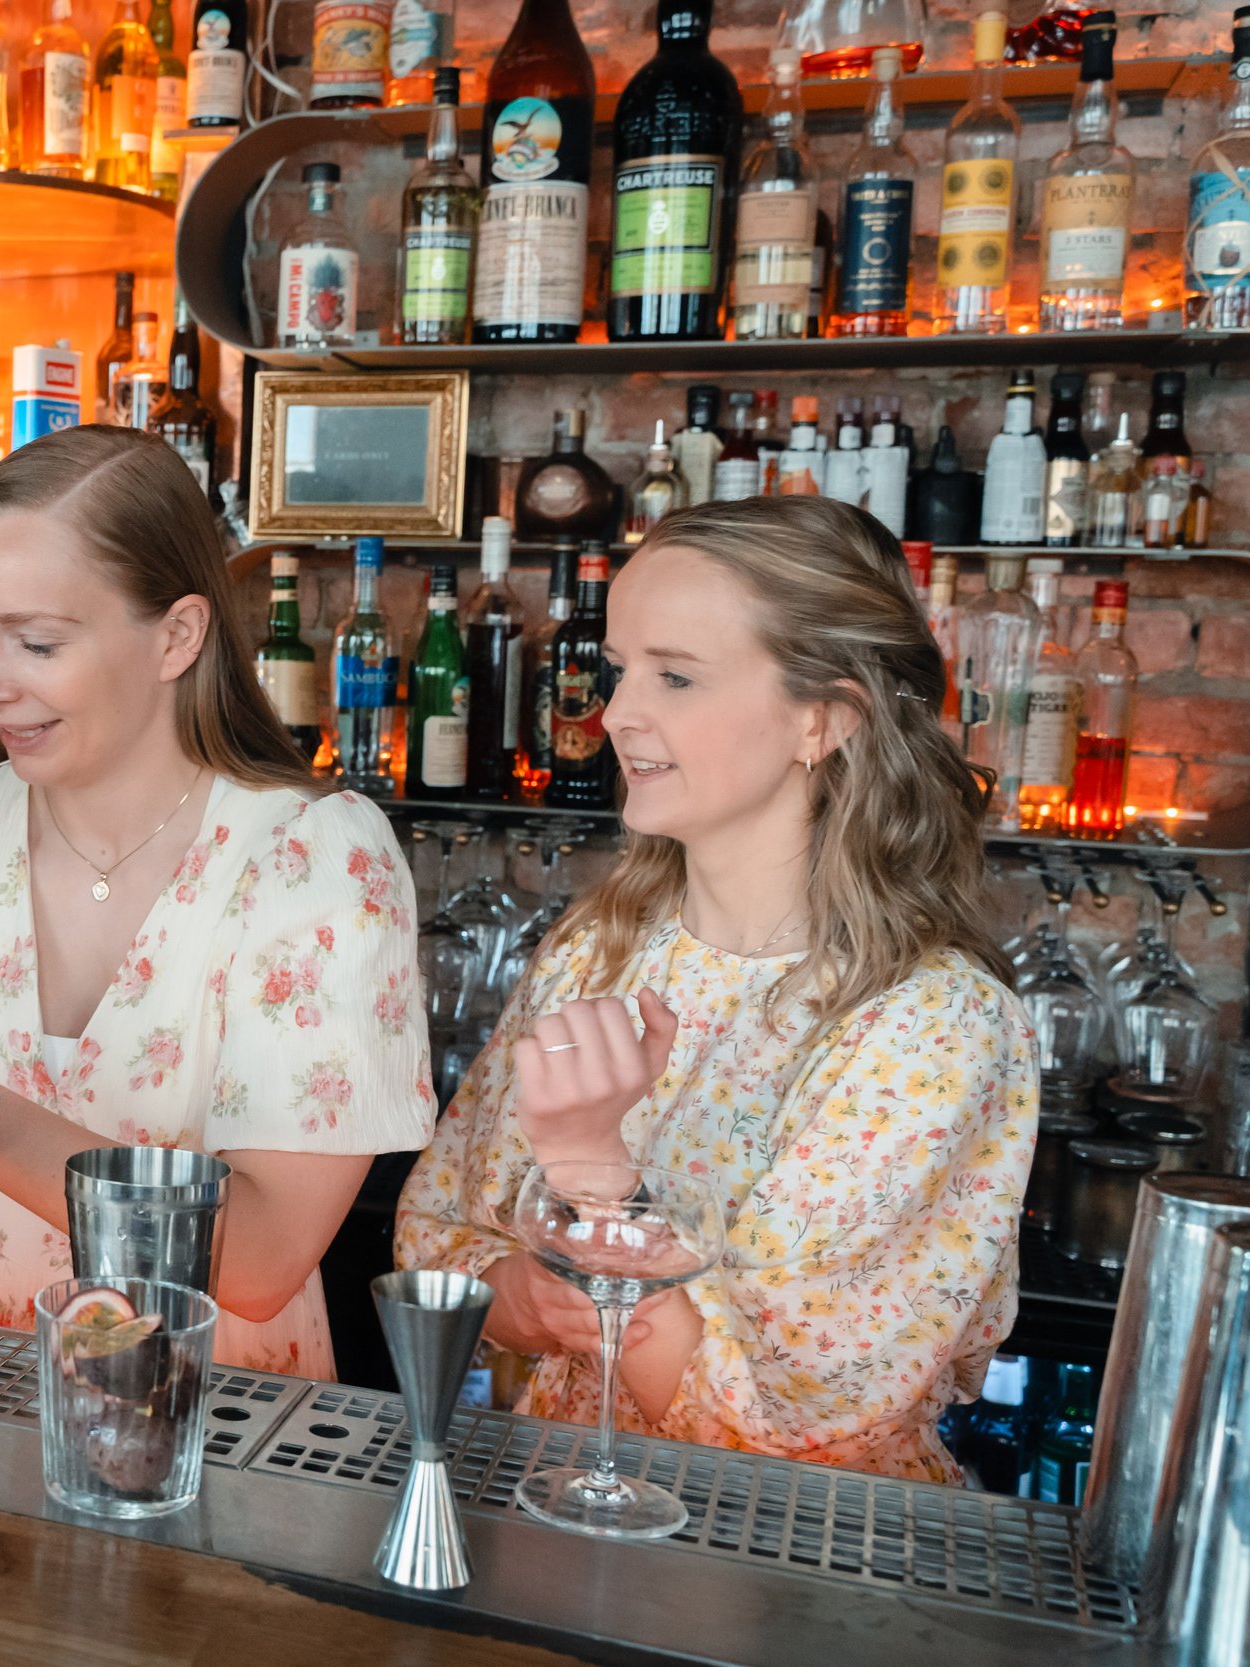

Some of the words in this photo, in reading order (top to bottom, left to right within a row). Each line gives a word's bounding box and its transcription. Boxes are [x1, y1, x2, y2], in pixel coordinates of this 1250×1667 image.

[617, 171, 715, 190] CHARTREUSE
[406, 237, 471, 249] CHARTREUSE
[287, 283, 303, 329] CAMPO
